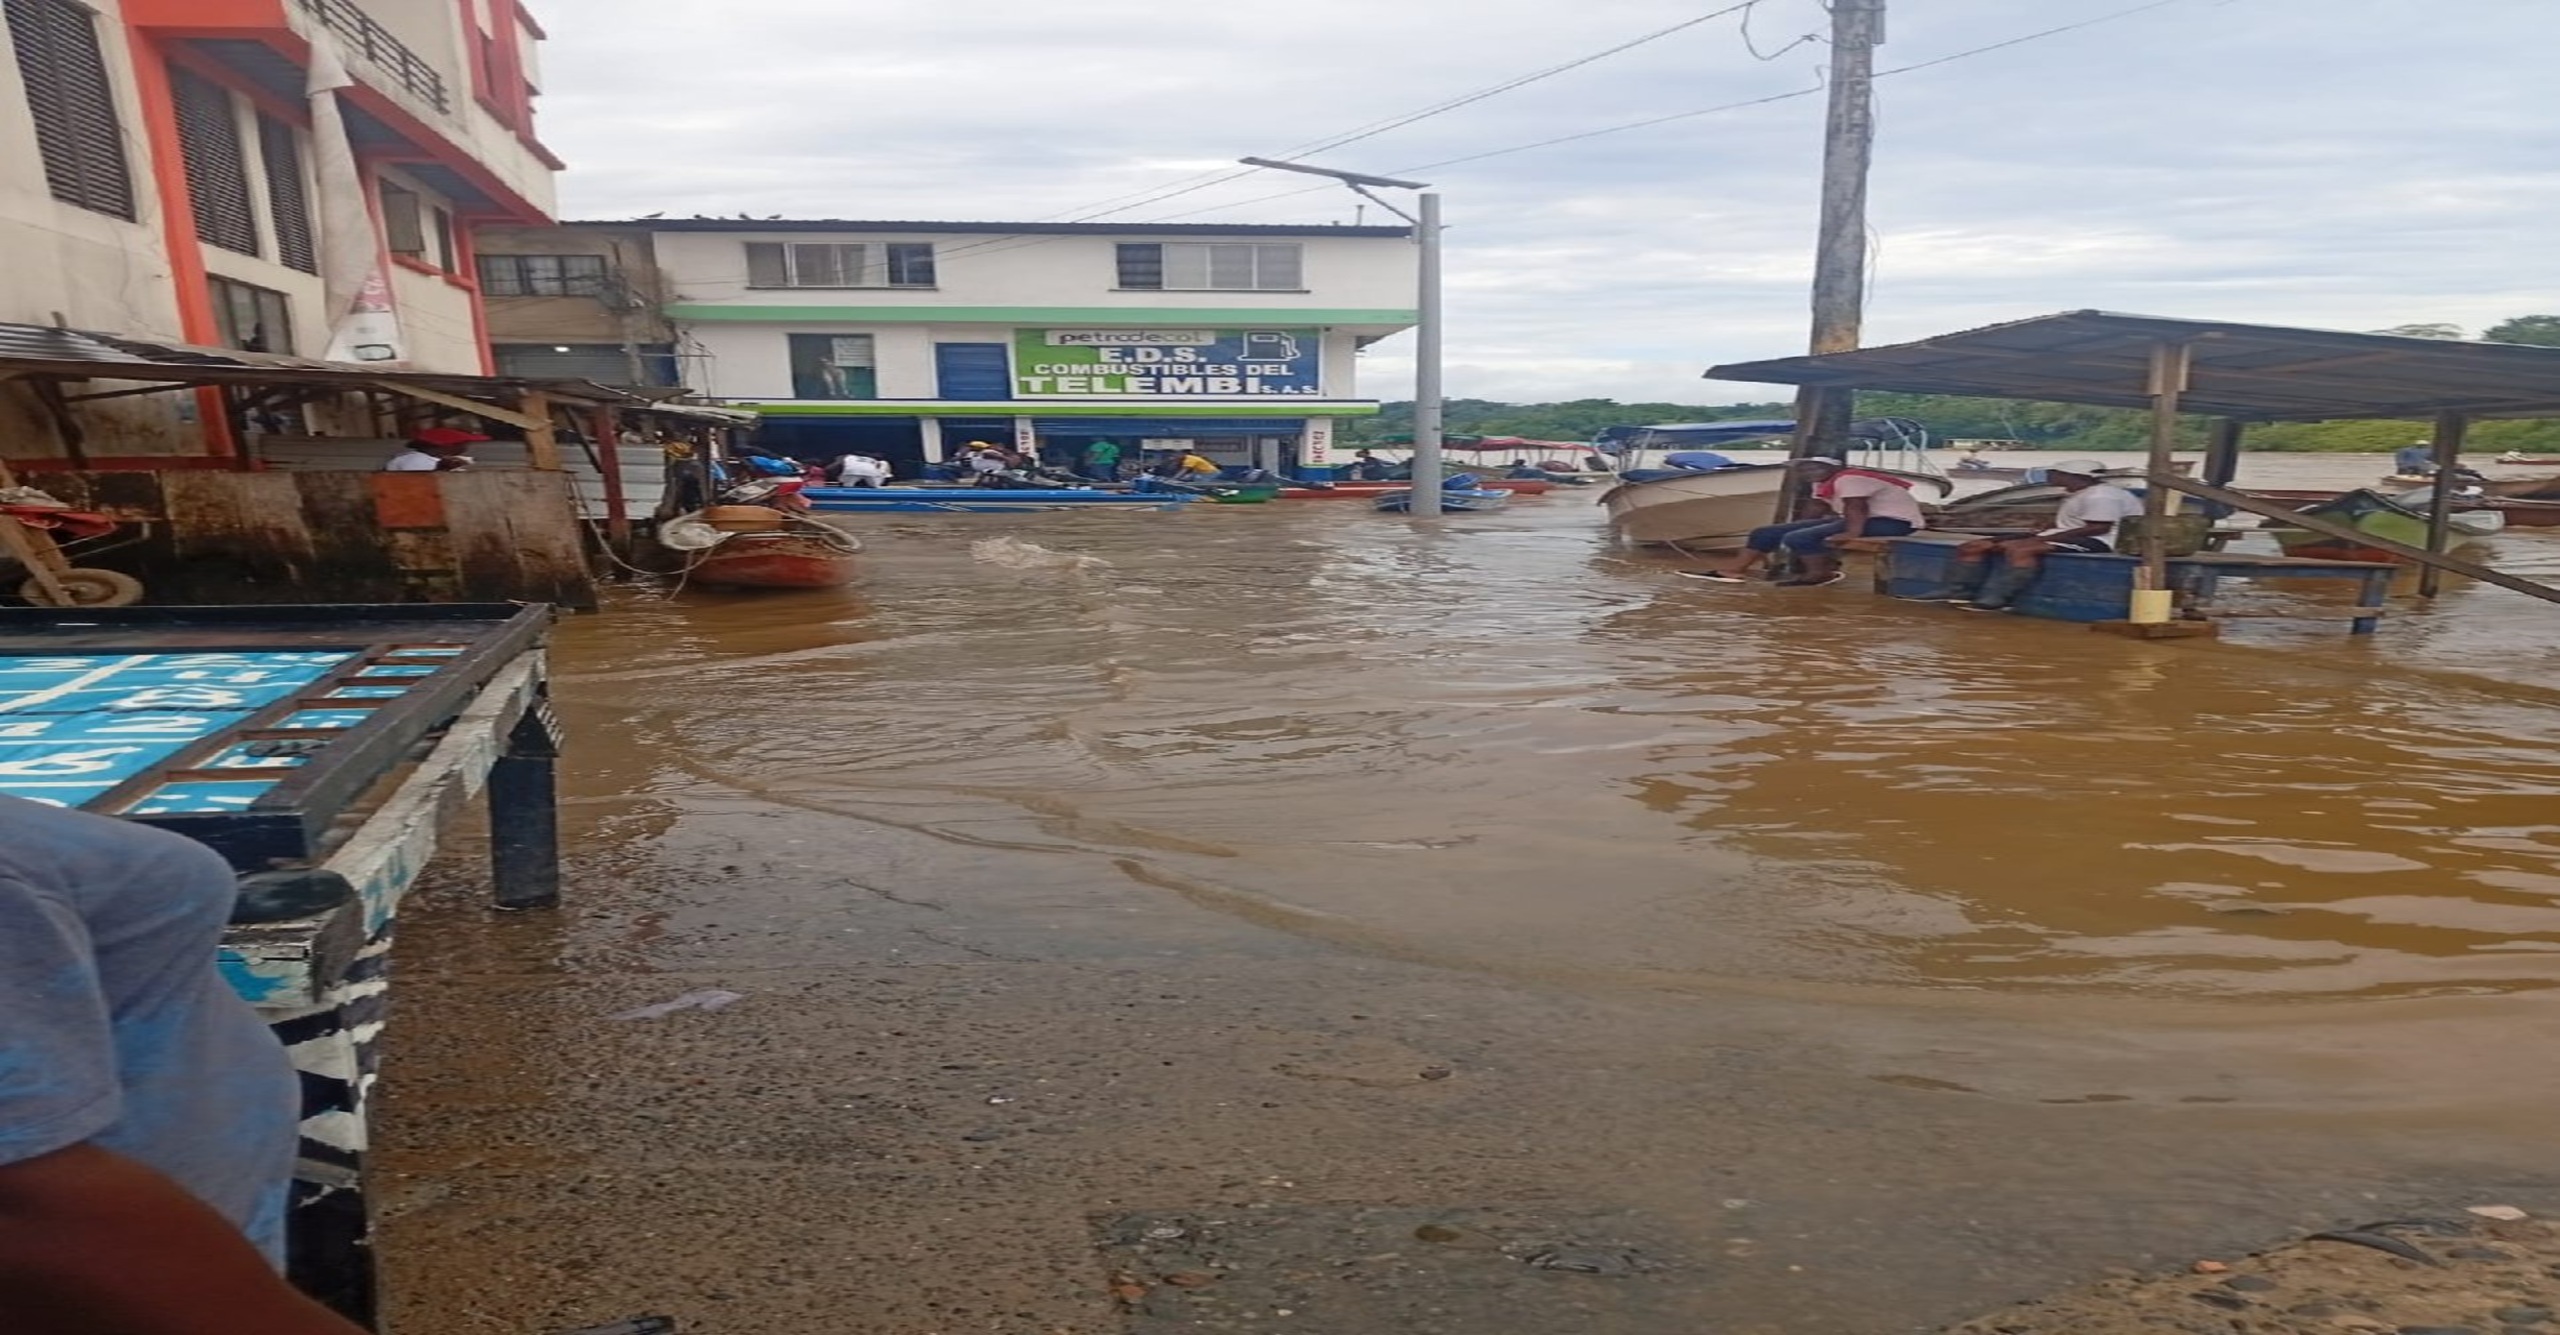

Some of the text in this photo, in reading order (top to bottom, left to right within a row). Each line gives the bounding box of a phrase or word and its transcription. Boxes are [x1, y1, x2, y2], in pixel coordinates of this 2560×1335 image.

[1059, 331, 1205, 344] petrodecol
[1100, 347, 1208, 363] E.D.S.
[1033, 364, 1294, 376] COMBUSTIBLES DEL
[1019, 377, 1261, 394] TELEMBI
